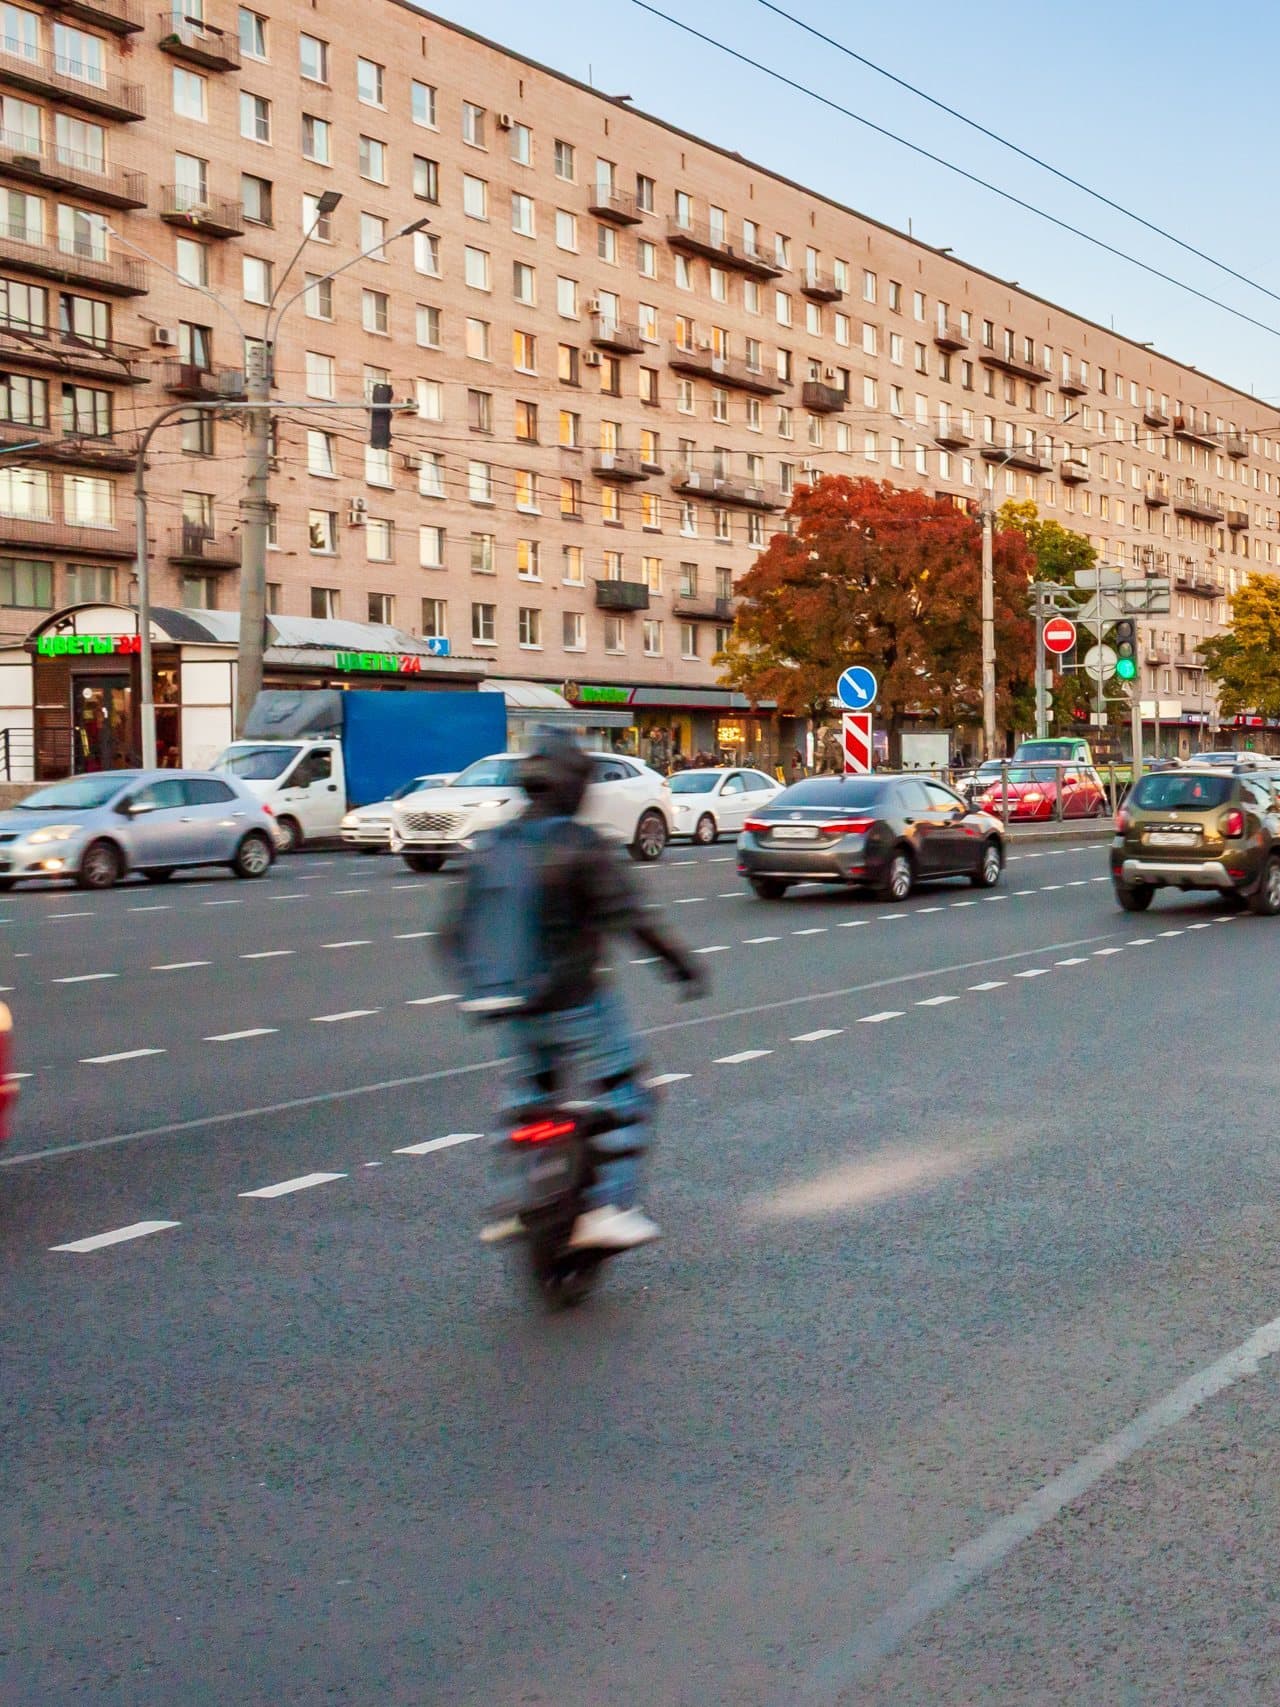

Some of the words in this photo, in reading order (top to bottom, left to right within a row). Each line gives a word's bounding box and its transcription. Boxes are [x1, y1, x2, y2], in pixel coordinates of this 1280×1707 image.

[38, 634, 114, 657] ЦВЕТЫ
[118, 634, 142, 654] 24
[336, 652, 398, 672] ЦВЕТЫ
[400, 655, 421, 673] 24
